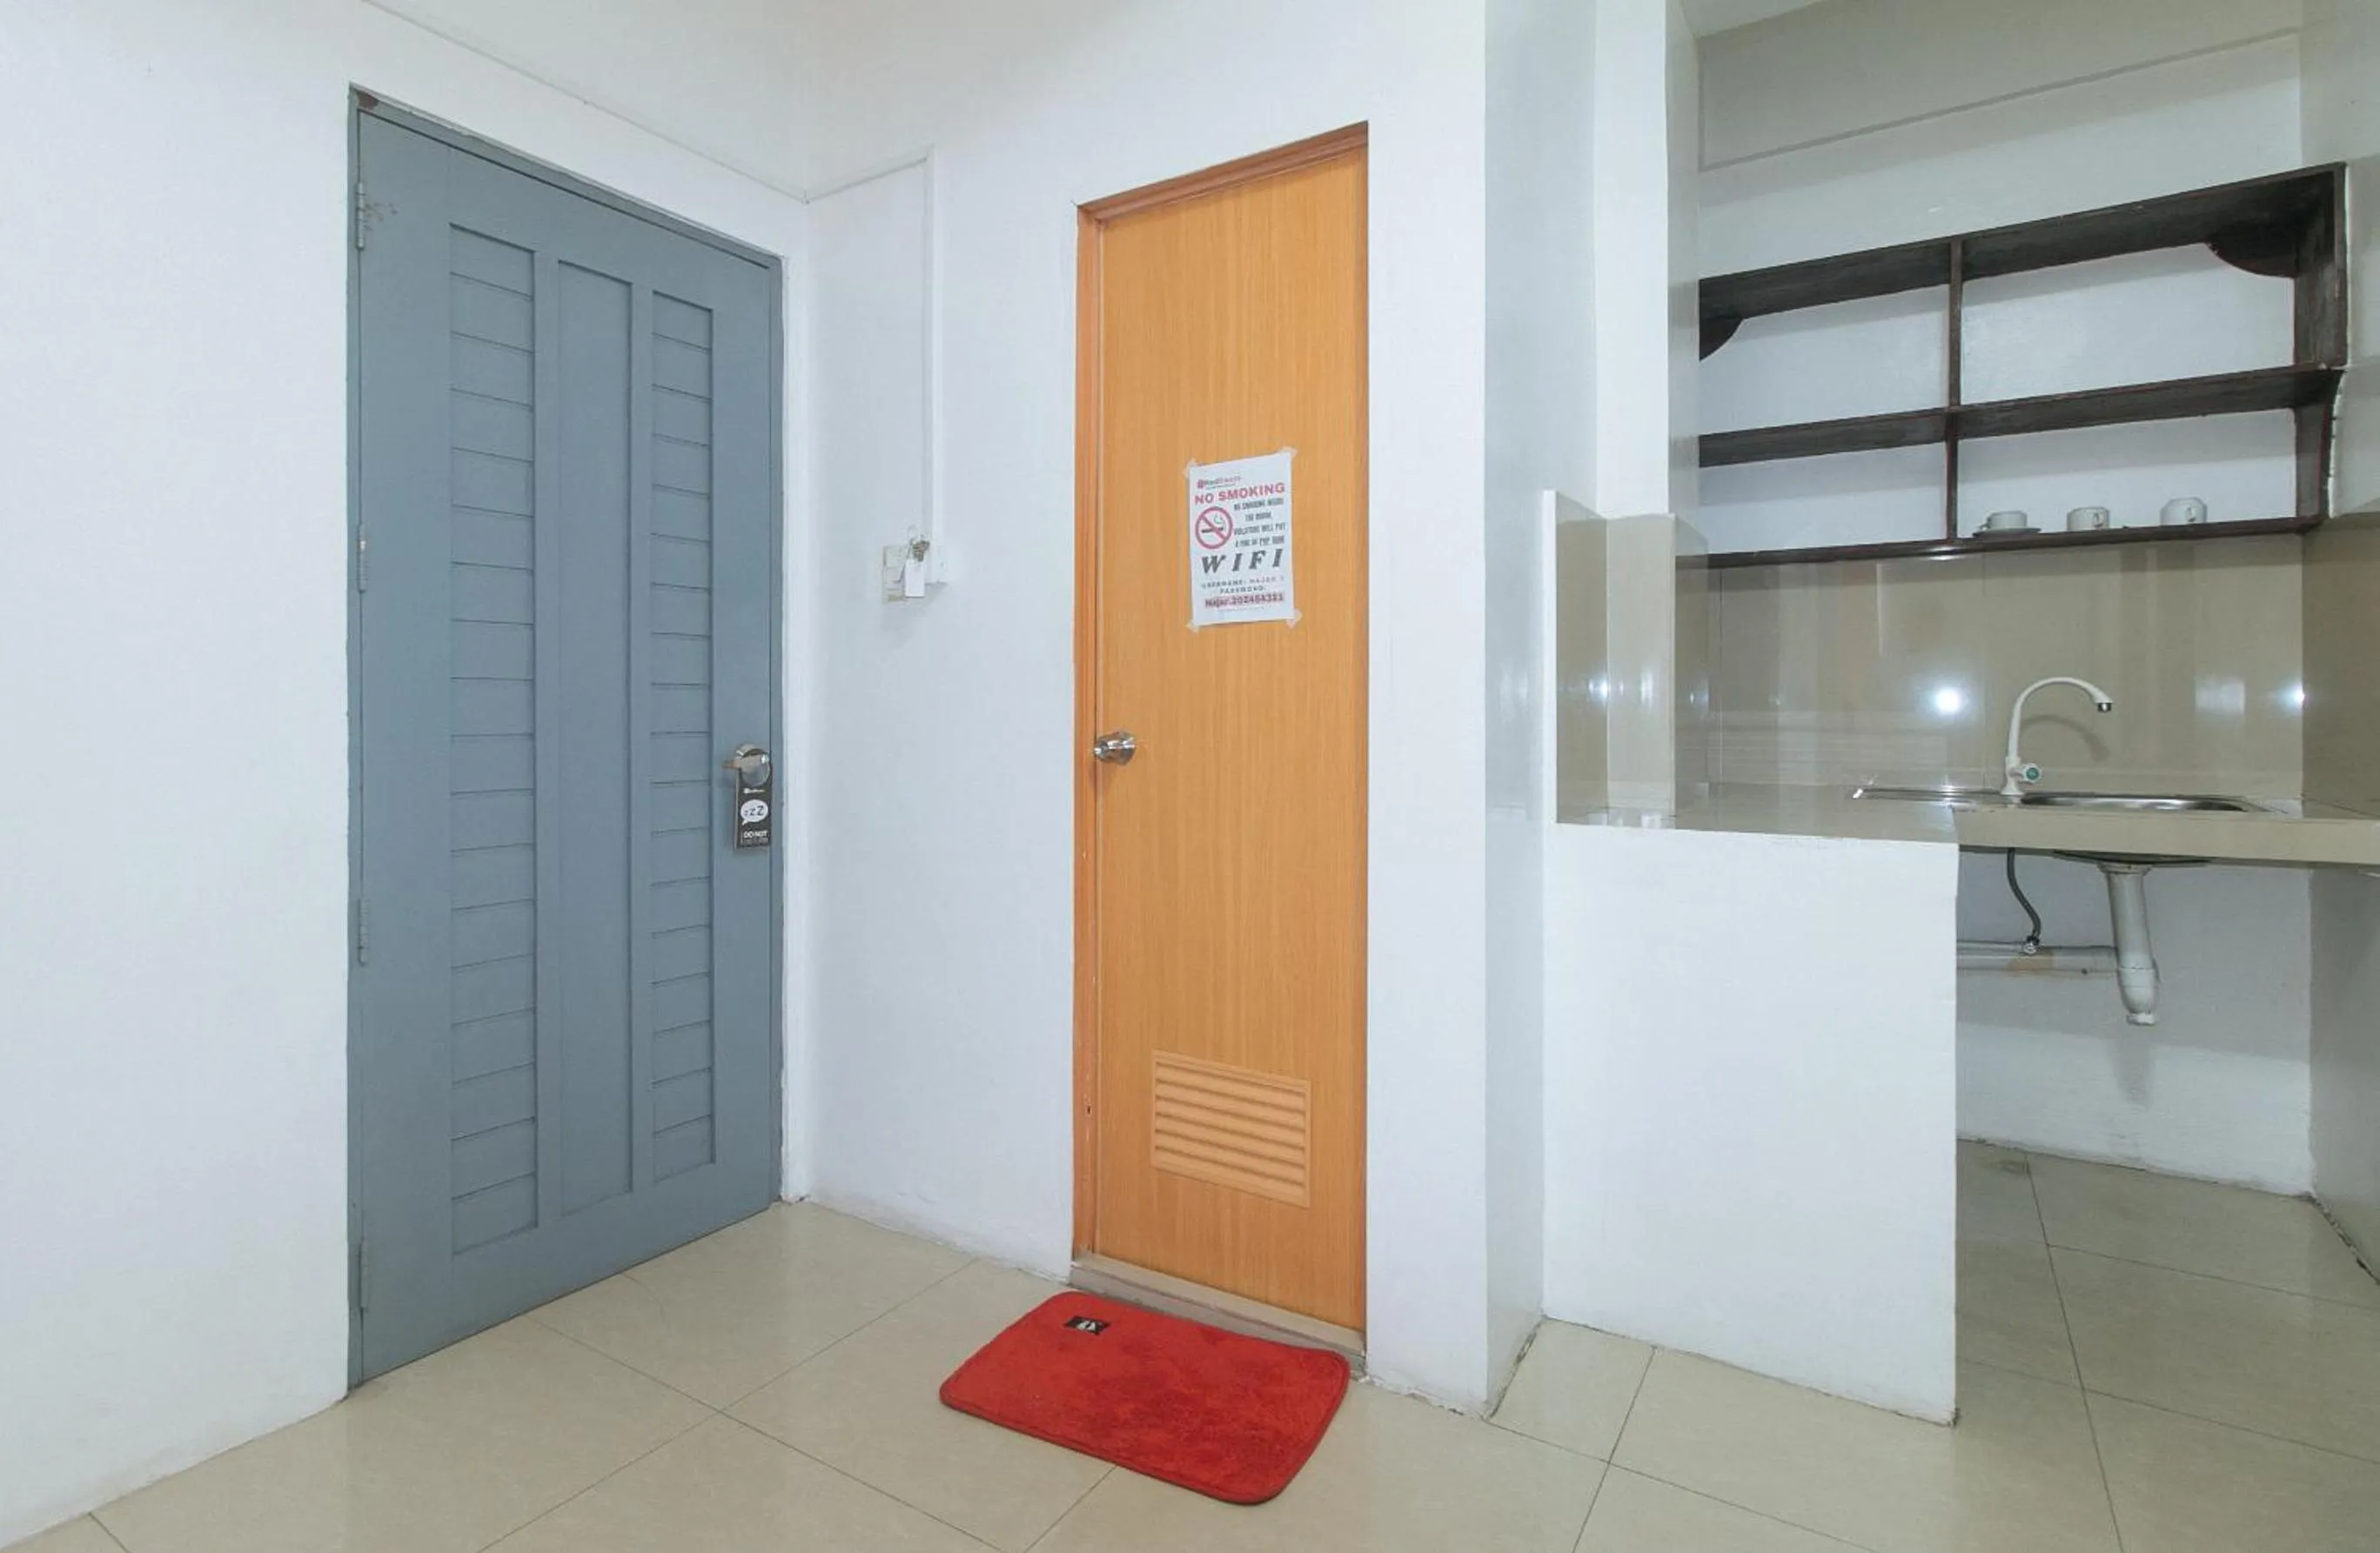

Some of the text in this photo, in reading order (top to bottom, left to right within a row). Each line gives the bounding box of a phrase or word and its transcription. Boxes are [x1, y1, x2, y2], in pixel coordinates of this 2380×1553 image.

[1195, 493, 1214, 504] NO
[1218, 482, 1284, 501] SMOKING
[1201, 548, 1283, 573] WIFI
